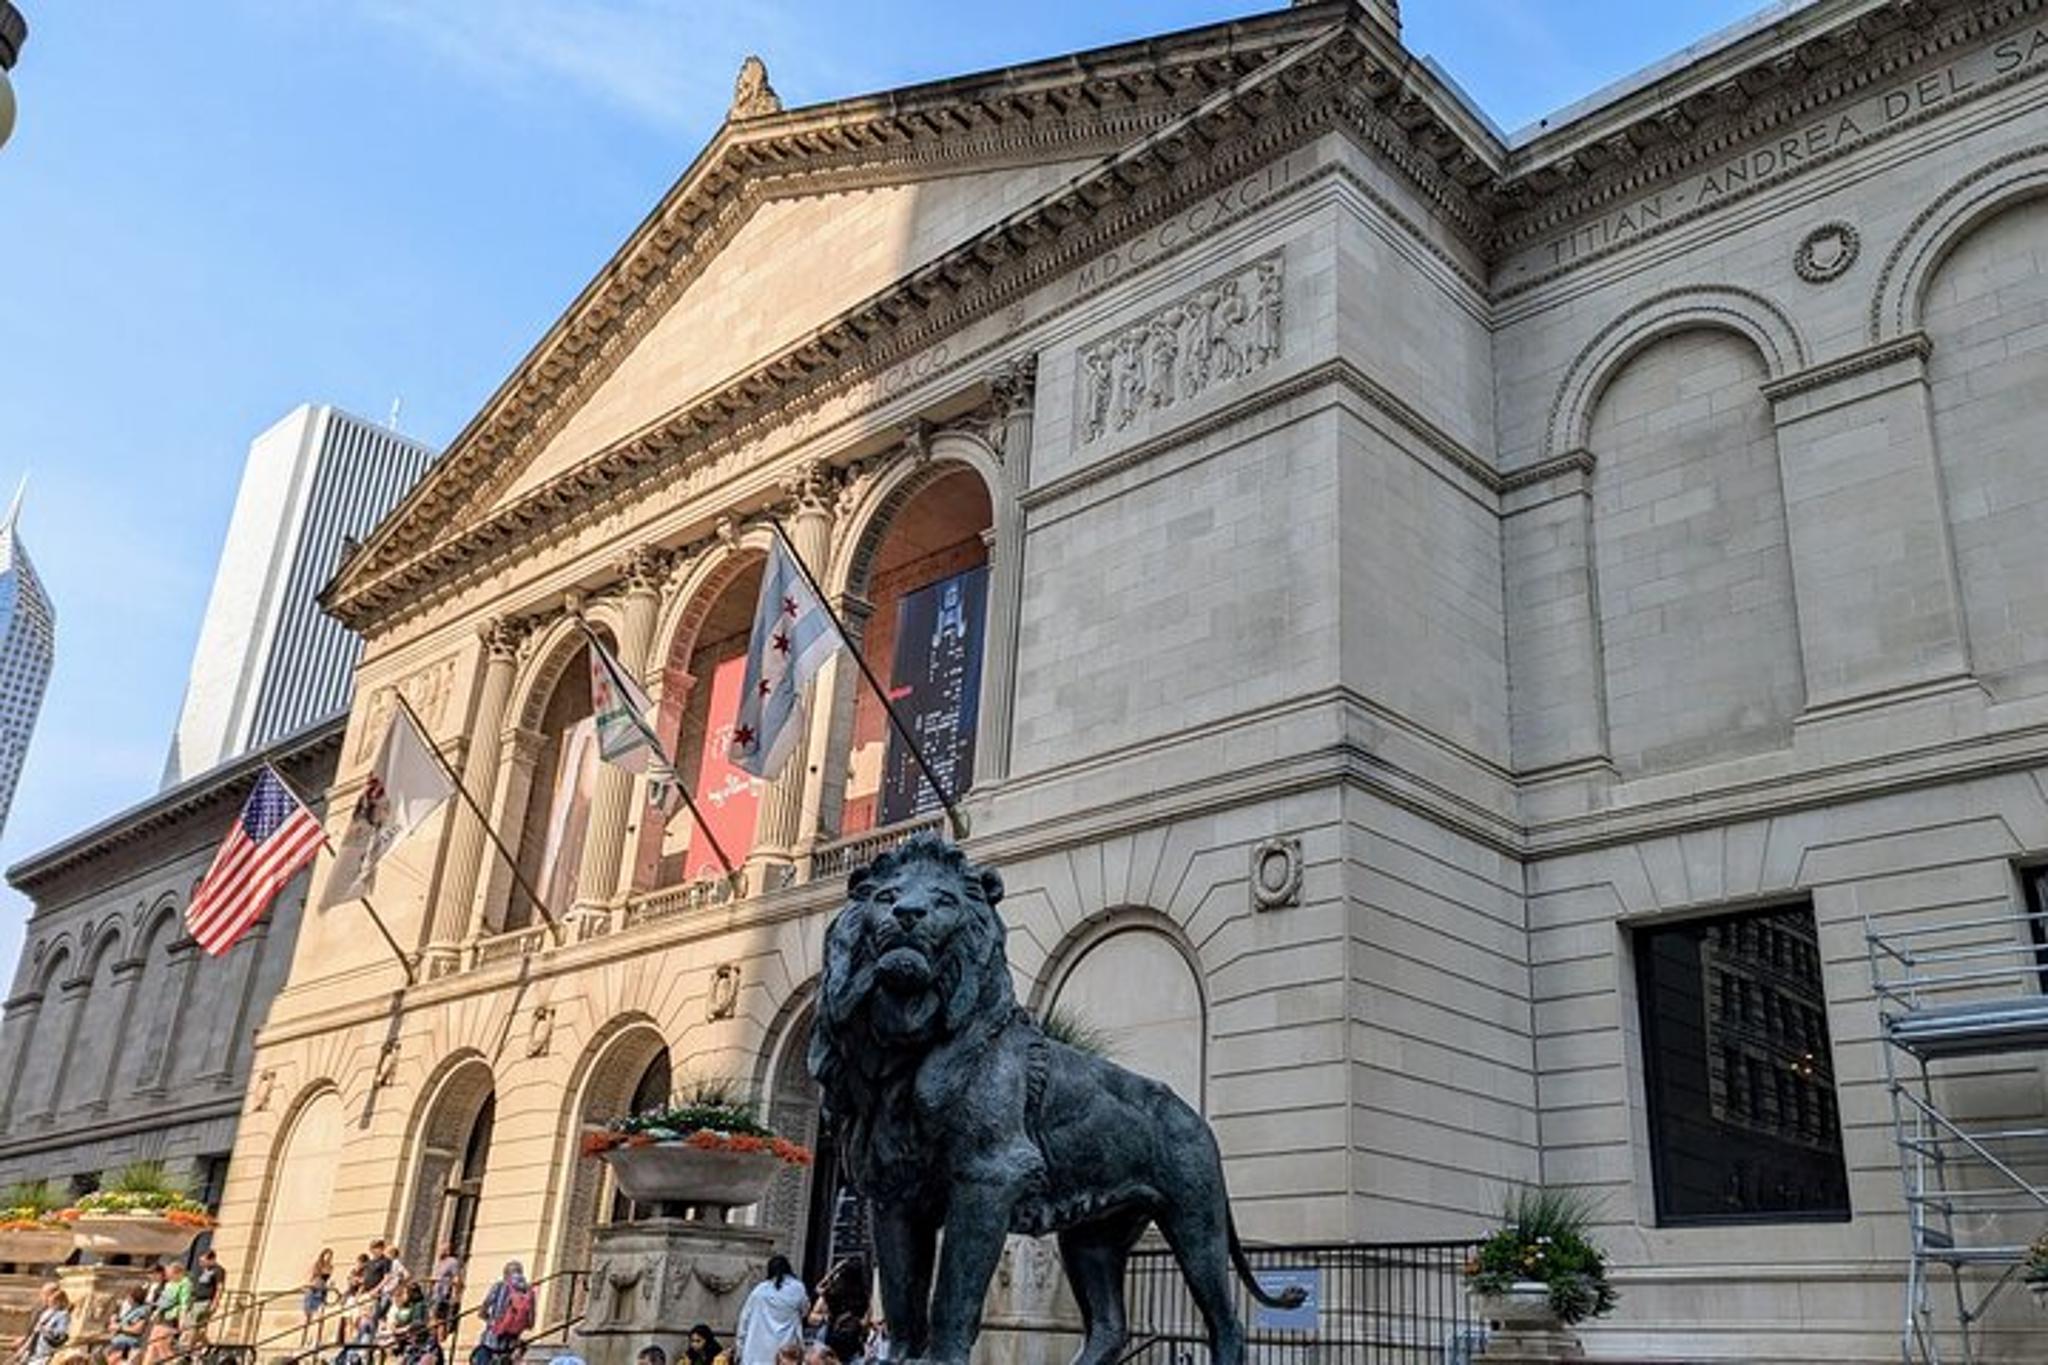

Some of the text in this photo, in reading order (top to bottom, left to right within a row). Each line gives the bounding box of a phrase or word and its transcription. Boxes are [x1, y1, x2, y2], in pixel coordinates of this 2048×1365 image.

[1077, 159, 1290, 290] MDCCCXCII
[1547, 196, 1664, 266] TITIAN
[1697, 117, 1862, 203] ANDREA
[1883, 68, 1975, 122] DEL
[844, 343, 950, 412] CHICAGO
